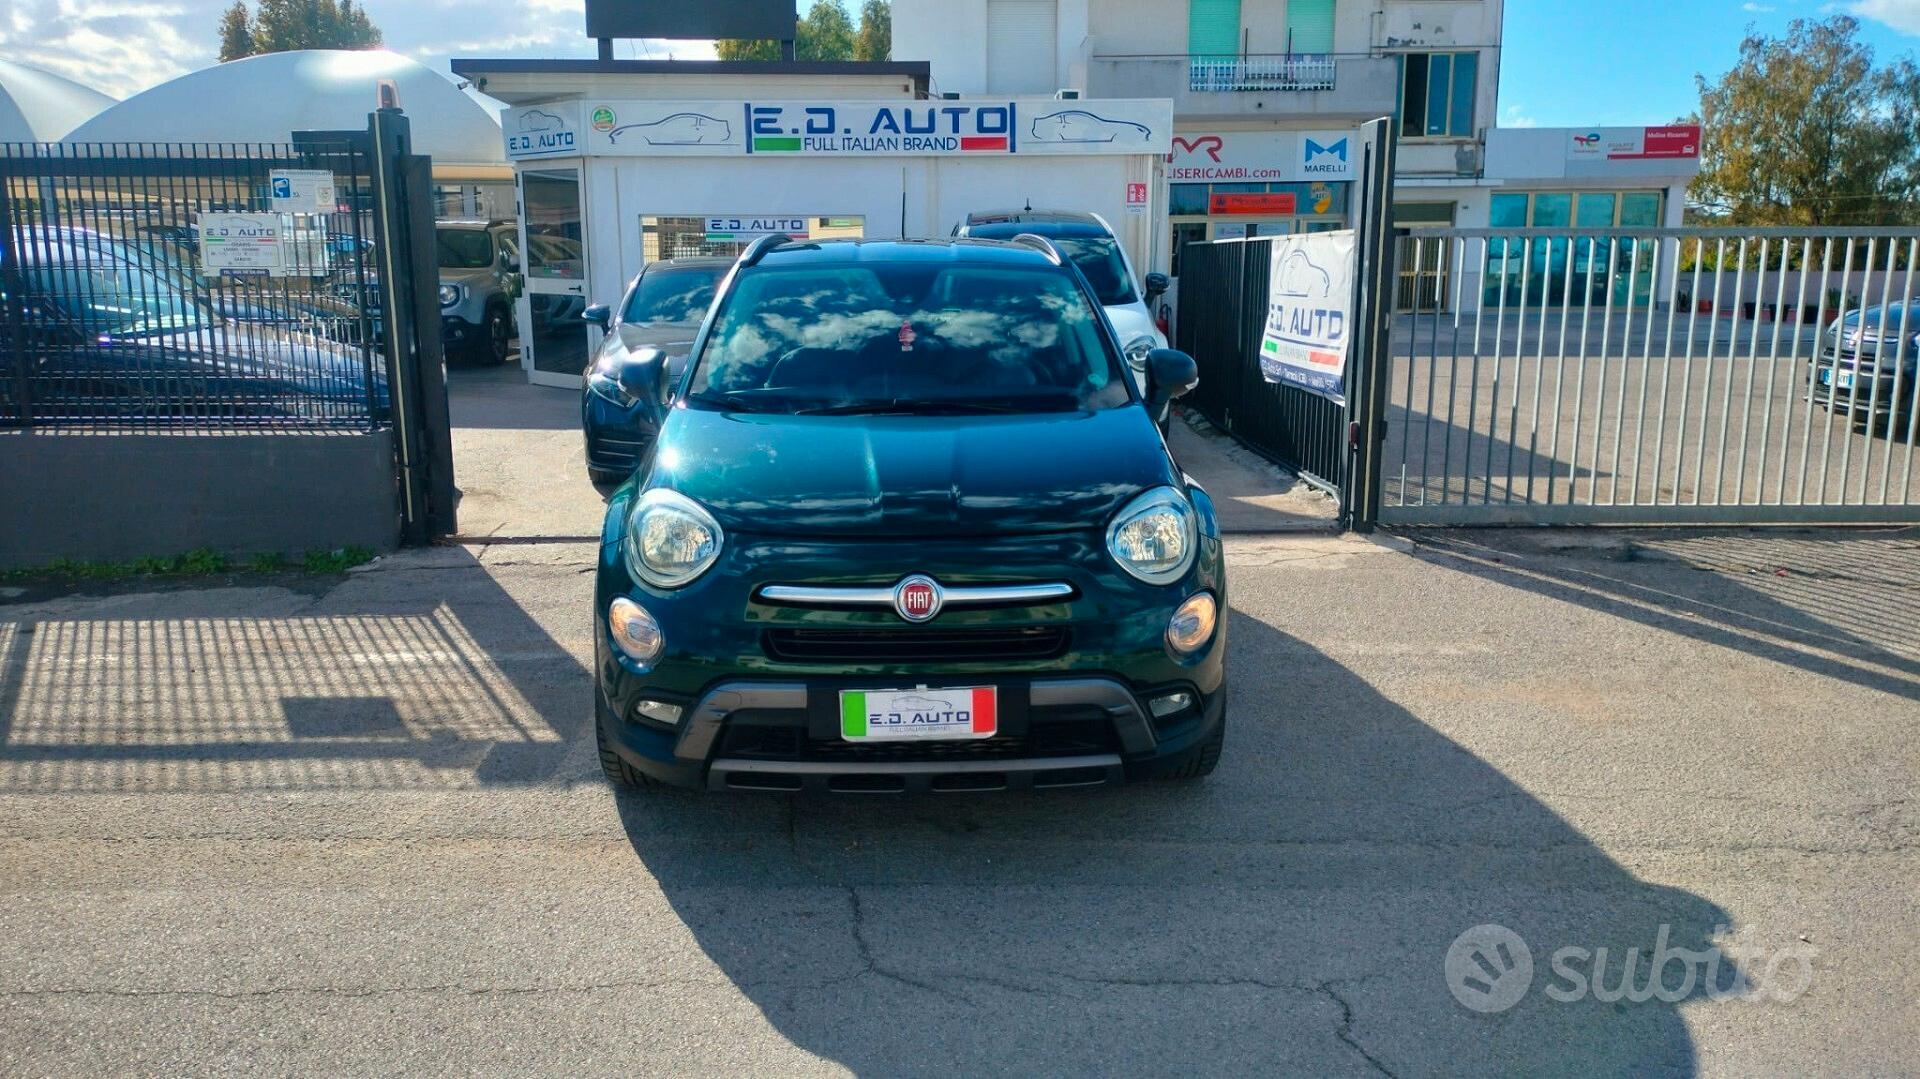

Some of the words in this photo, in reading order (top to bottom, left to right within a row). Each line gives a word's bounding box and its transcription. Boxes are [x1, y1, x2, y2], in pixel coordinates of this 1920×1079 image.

[753, 107, 851, 134] E.D.
[869, 107, 1008, 134] AUTO
[510, 136, 534, 150] E.D.
[539, 132, 574, 147] AUTO
[804, 137, 838, 151] FULL
[842, 137, 898, 151] ITALIAN
[903, 137, 958, 151] BRAND
[1304, 164, 1347, 172] MARELLI
[711, 219, 745, 230] E.D.
[750, 219, 803, 230] AUTO
[238, 228, 276, 236] AUTO
[1290, 307, 1344, 340] AUTO
[907, 591, 931, 609] FIAT
[870, 713, 906, 725] E.D.
[912, 711, 970, 724] AUTO
